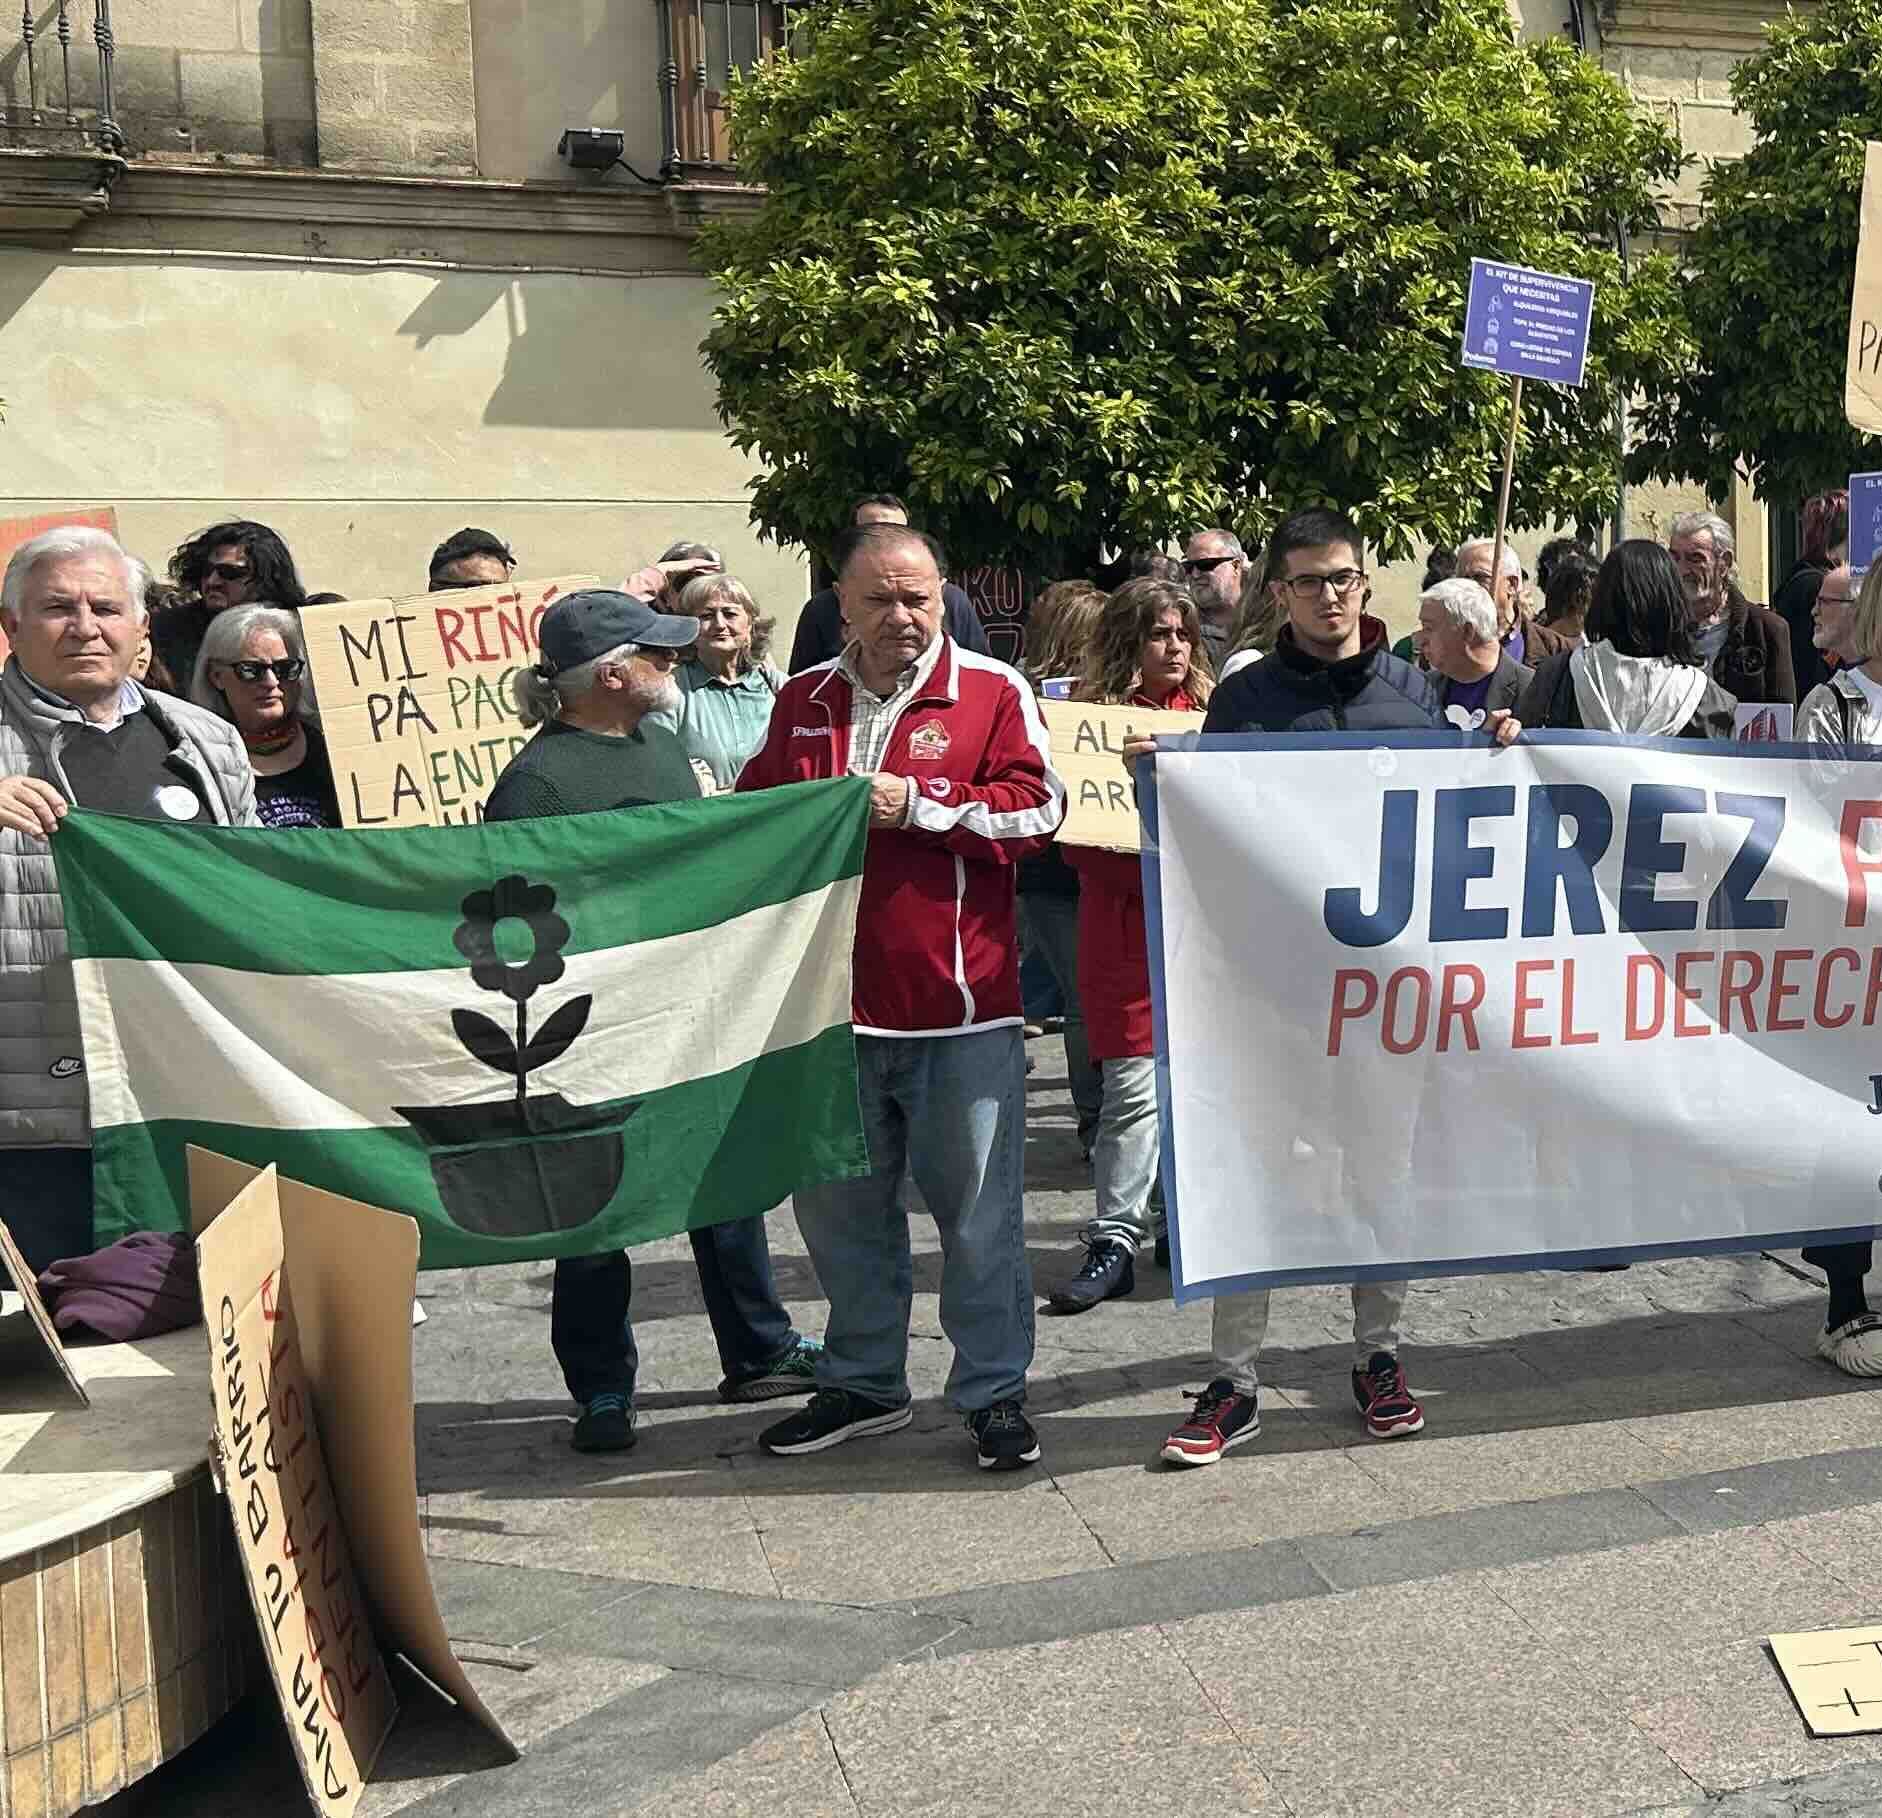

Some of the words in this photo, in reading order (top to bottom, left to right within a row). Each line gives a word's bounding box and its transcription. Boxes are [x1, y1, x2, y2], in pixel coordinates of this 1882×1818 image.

[1866, 479, 1876, 488] EL
[339, 615, 427, 686] MI
[367, 685, 437, 742] PA
[350, 763, 425, 824] LA
[1324, 784, 1789, 947] JEREZ
[1326, 964, 1486, 1056] POR
[1512, 959, 1599, 1049] EL
[263, 1562, 284, 1655] TU
[293, 1653, 347, 1799] AMA
